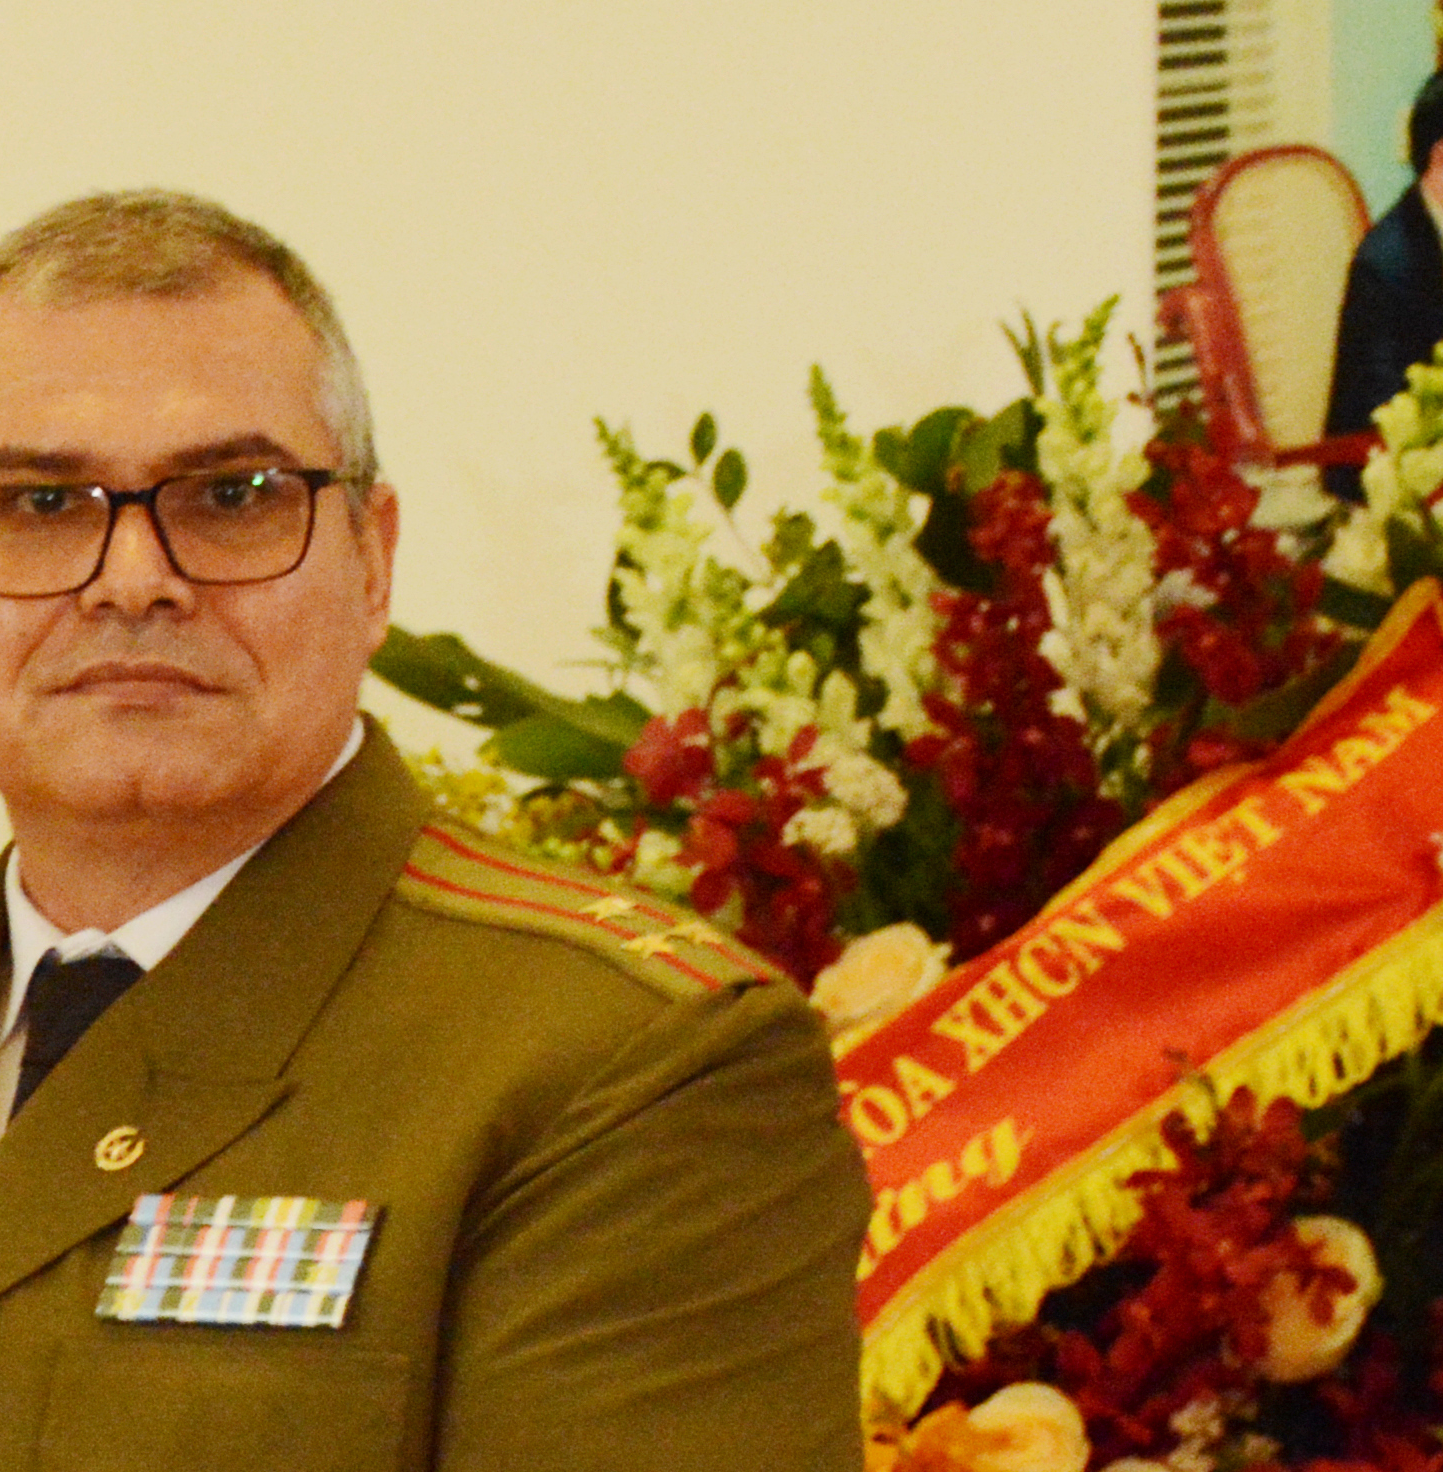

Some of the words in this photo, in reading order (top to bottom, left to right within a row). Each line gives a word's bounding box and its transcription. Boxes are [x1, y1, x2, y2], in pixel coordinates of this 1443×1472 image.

[837, 1055, 958, 1162] ÒA
[929, 898, 1128, 1074] XHCN
[1112, 796, 1284, 920] VIỆT
[1274, 684, 1440, 816] NAM
